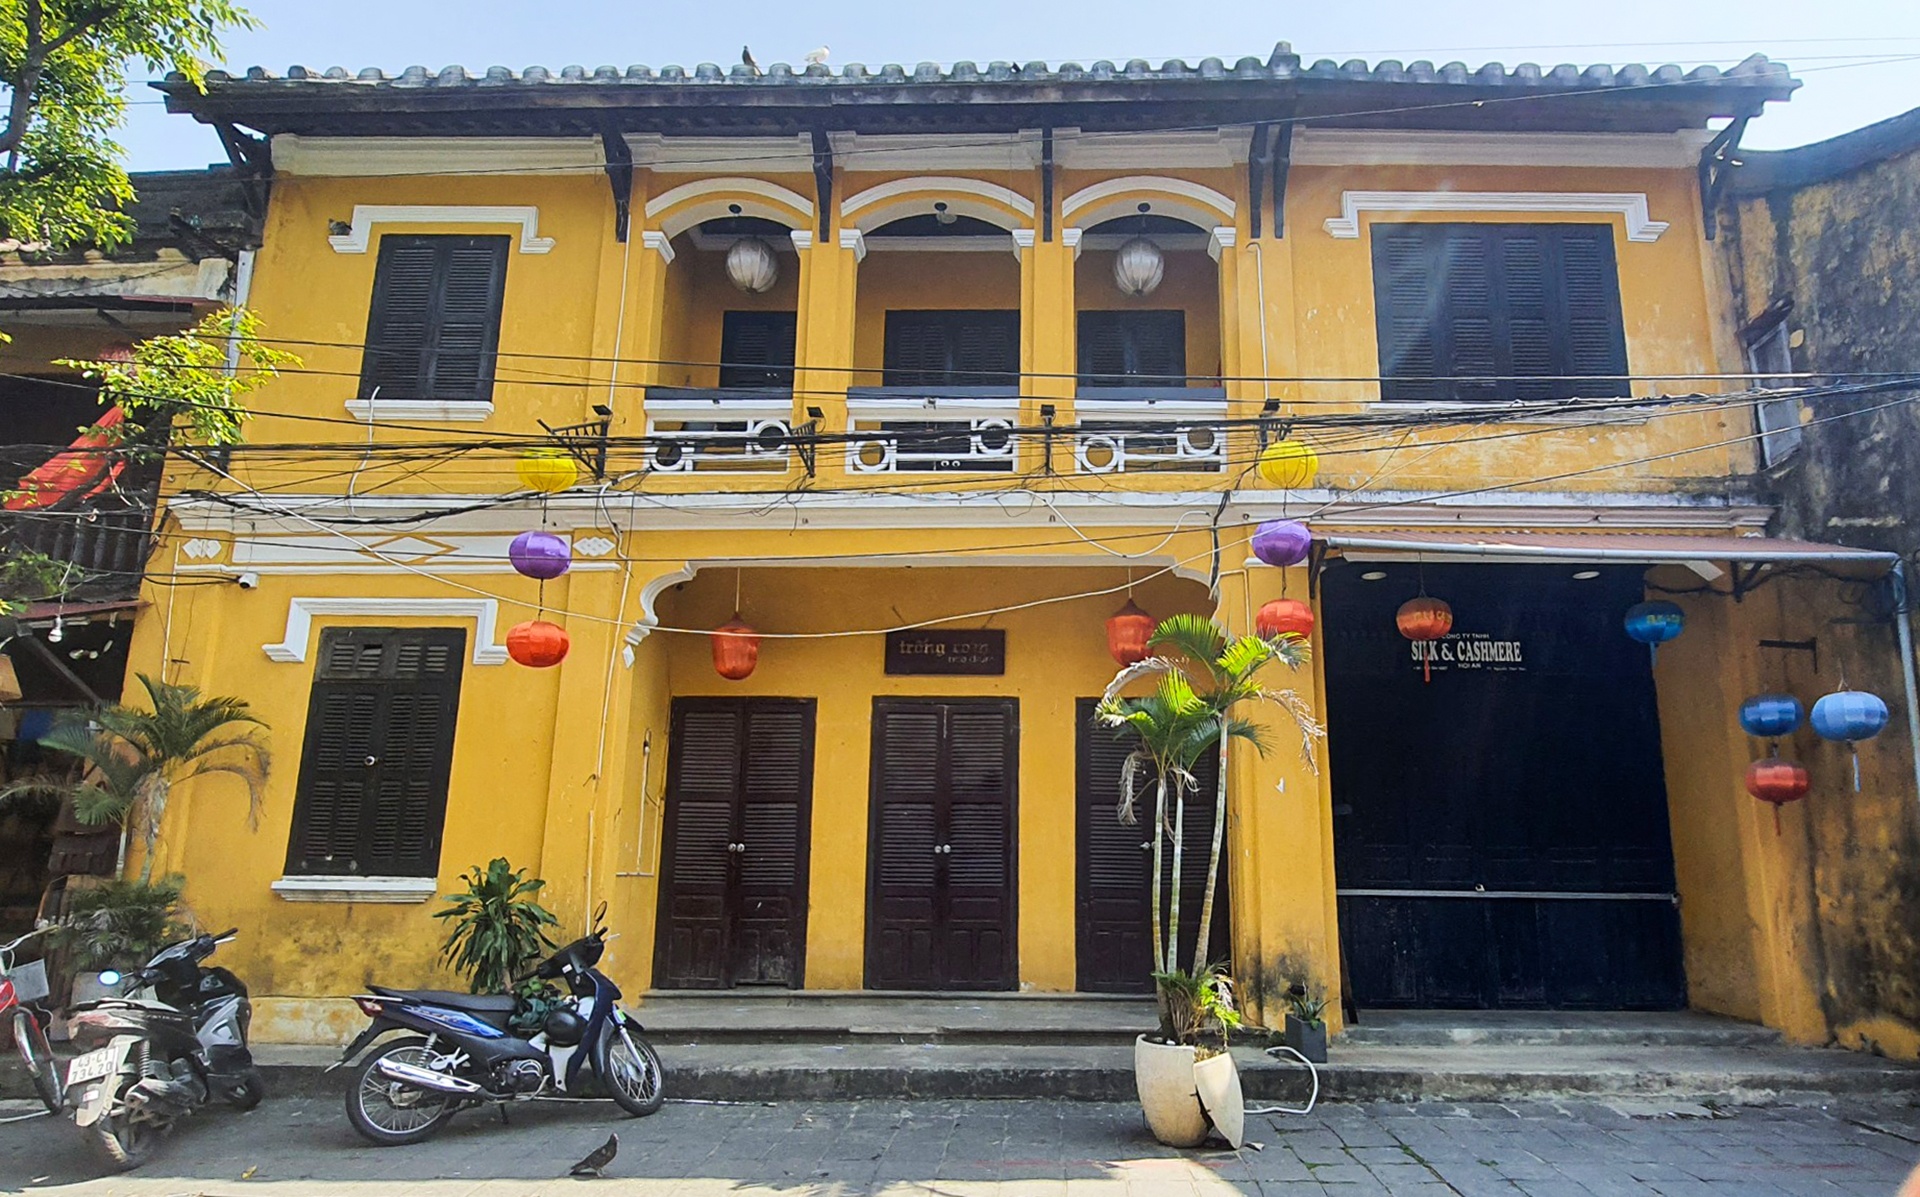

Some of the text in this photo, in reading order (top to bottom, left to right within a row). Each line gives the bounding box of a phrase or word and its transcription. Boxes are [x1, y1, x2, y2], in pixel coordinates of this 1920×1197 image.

[1411, 640, 1522, 662] SILK & CASHMERE
